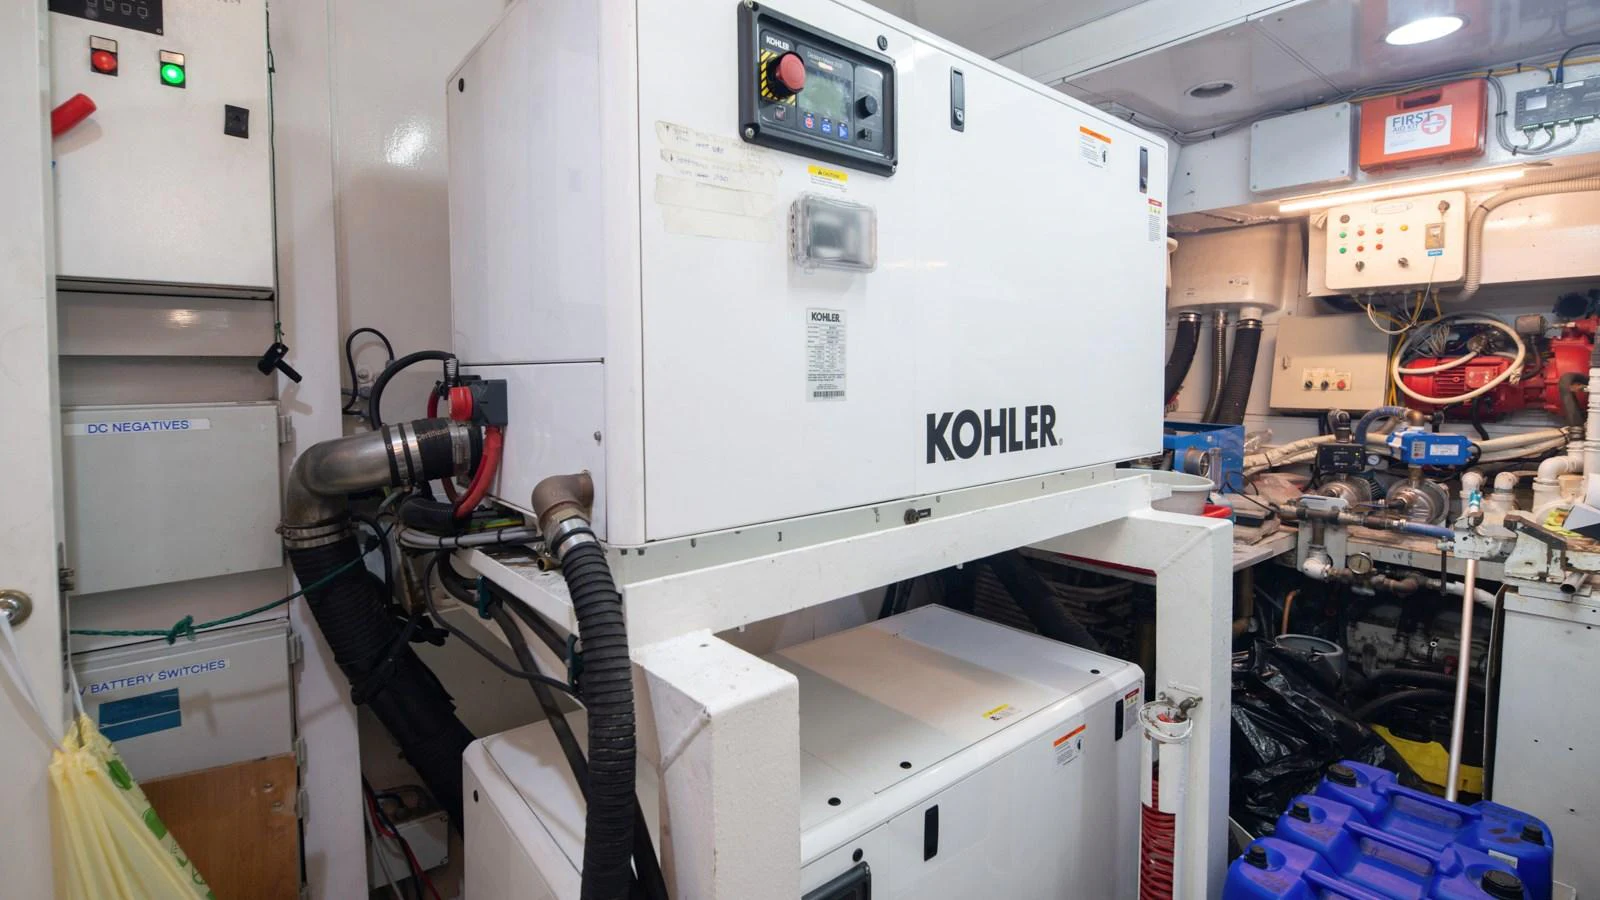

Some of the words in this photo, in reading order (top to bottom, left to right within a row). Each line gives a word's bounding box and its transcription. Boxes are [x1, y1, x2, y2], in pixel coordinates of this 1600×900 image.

[766, 36, 790, 50] KOHLER
[1392, 110, 1434, 127] FIRST
[1392, 125, 1405, 133] AID
[811, 311, 841, 322] KOHLER
[87, 423, 109, 434] DC
[112, 419, 190, 433] NEGATIVES
[926, 404, 1058, 464] KOHLER
[90, 673, 154, 694] BATTERY
[158, 659, 226, 681] SWITCHES
